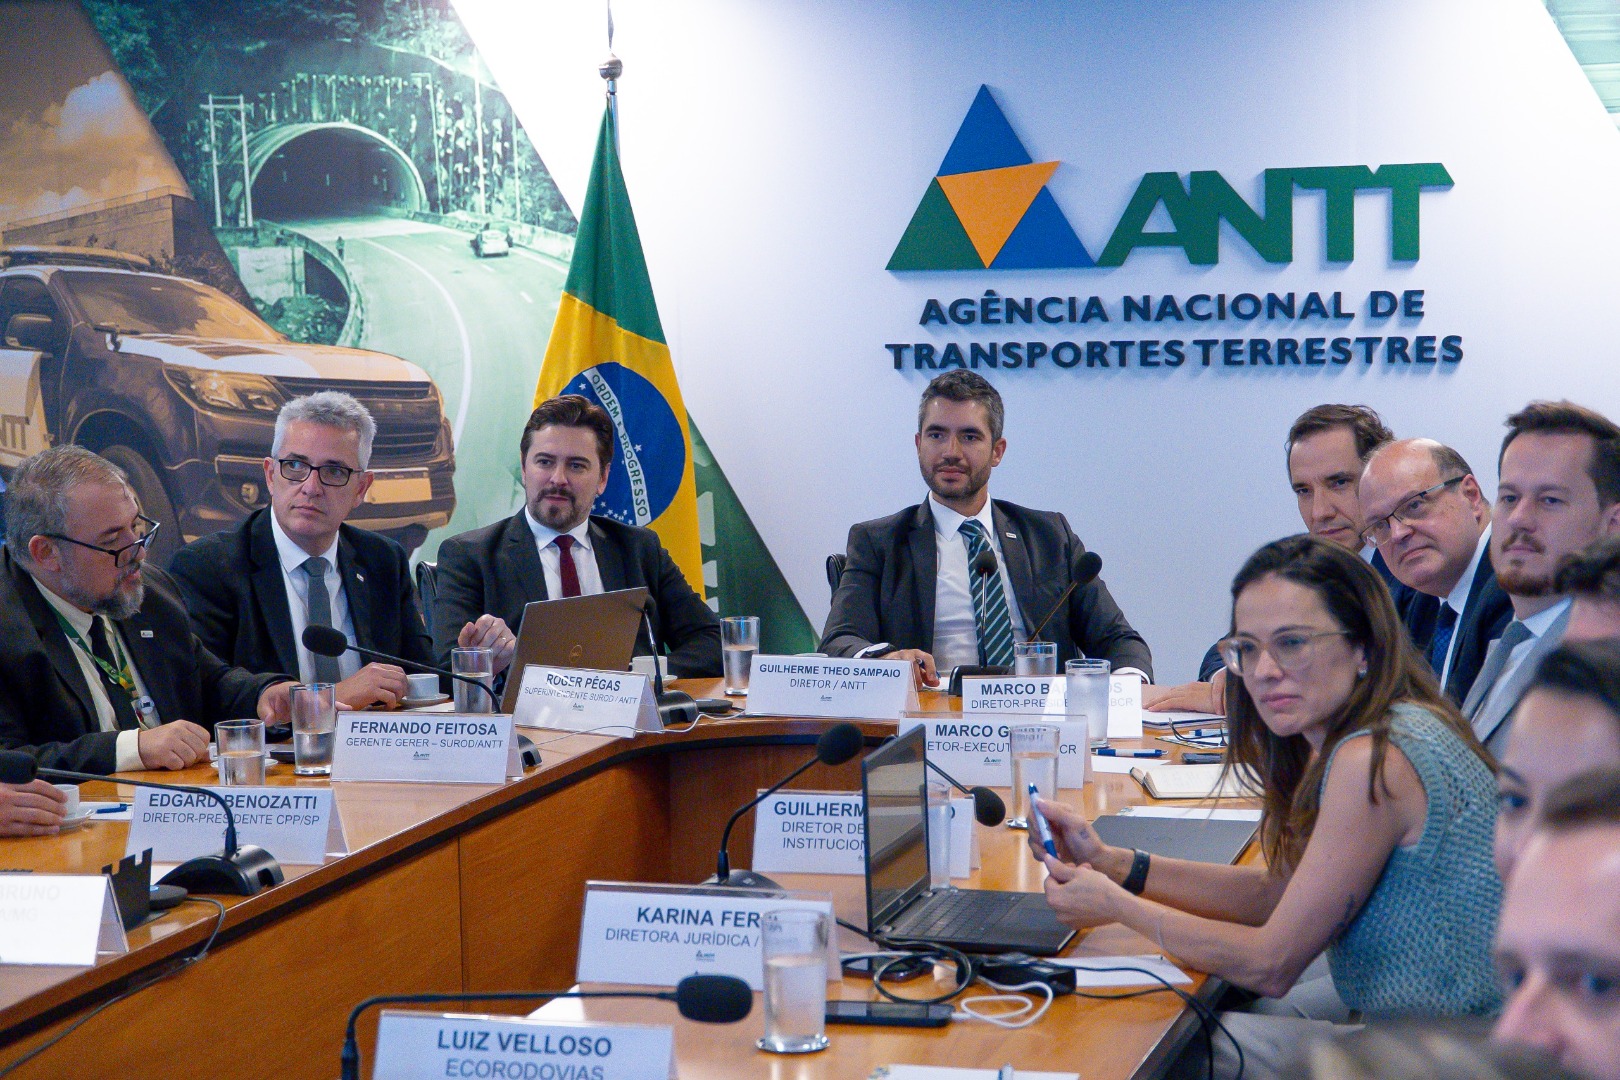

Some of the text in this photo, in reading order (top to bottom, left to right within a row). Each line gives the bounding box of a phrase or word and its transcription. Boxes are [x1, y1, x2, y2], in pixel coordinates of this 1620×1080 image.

[1096, 163, 1455, 266] ANTT
[920, 290, 1425, 326] AGÊNCIA NACIONAL DE
[885, 335, 1464, 370] TRANSPORTES TERRESTRES
[591, 373, 620, 419] ORDEM
[619, 432, 649, 518] PROGRESSO
[759, 663, 901, 678] GUILHERME THEO SAMPAIO
[546, 673, 621, 692] ROGER PÊGAS
[789, 678, 831, 689] DIRETOR
[840, 681, 867, 691] ANTT
[981, 683, 1036, 695] MARCO
[618, 696, 637, 705] ANTT
[971, 697, 1134, 709] DIRETOR-PRESIDE BCR
[350, 721, 498, 736] FERNANDO FEITOSA
[935, 724, 993, 738] MARCO
[346, 737, 392, 747] GERENTE
[395, 738, 429, 748] GERER
[440, 739, 504, 749] SUROD/ANTT
[149, 793, 318, 810] EDGARD BENOZATTI
[773, 800, 865, 817] GUILHERM
[143, 812, 320, 827] DIRETOR-PRESDENTE CPP/SP
[781, 821, 843, 835] DIRETOR
[783, 837, 865, 851] INSTITUCION
[636, 906, 714, 926] KARINA
[605, 927, 680, 944] DIRETORA
[684, 930, 751, 947] JURÍDICA
[437, 1029, 613, 1058] LUIZ VELLOSO
[445, 1057, 605, 1080] ECORODOVIAS
